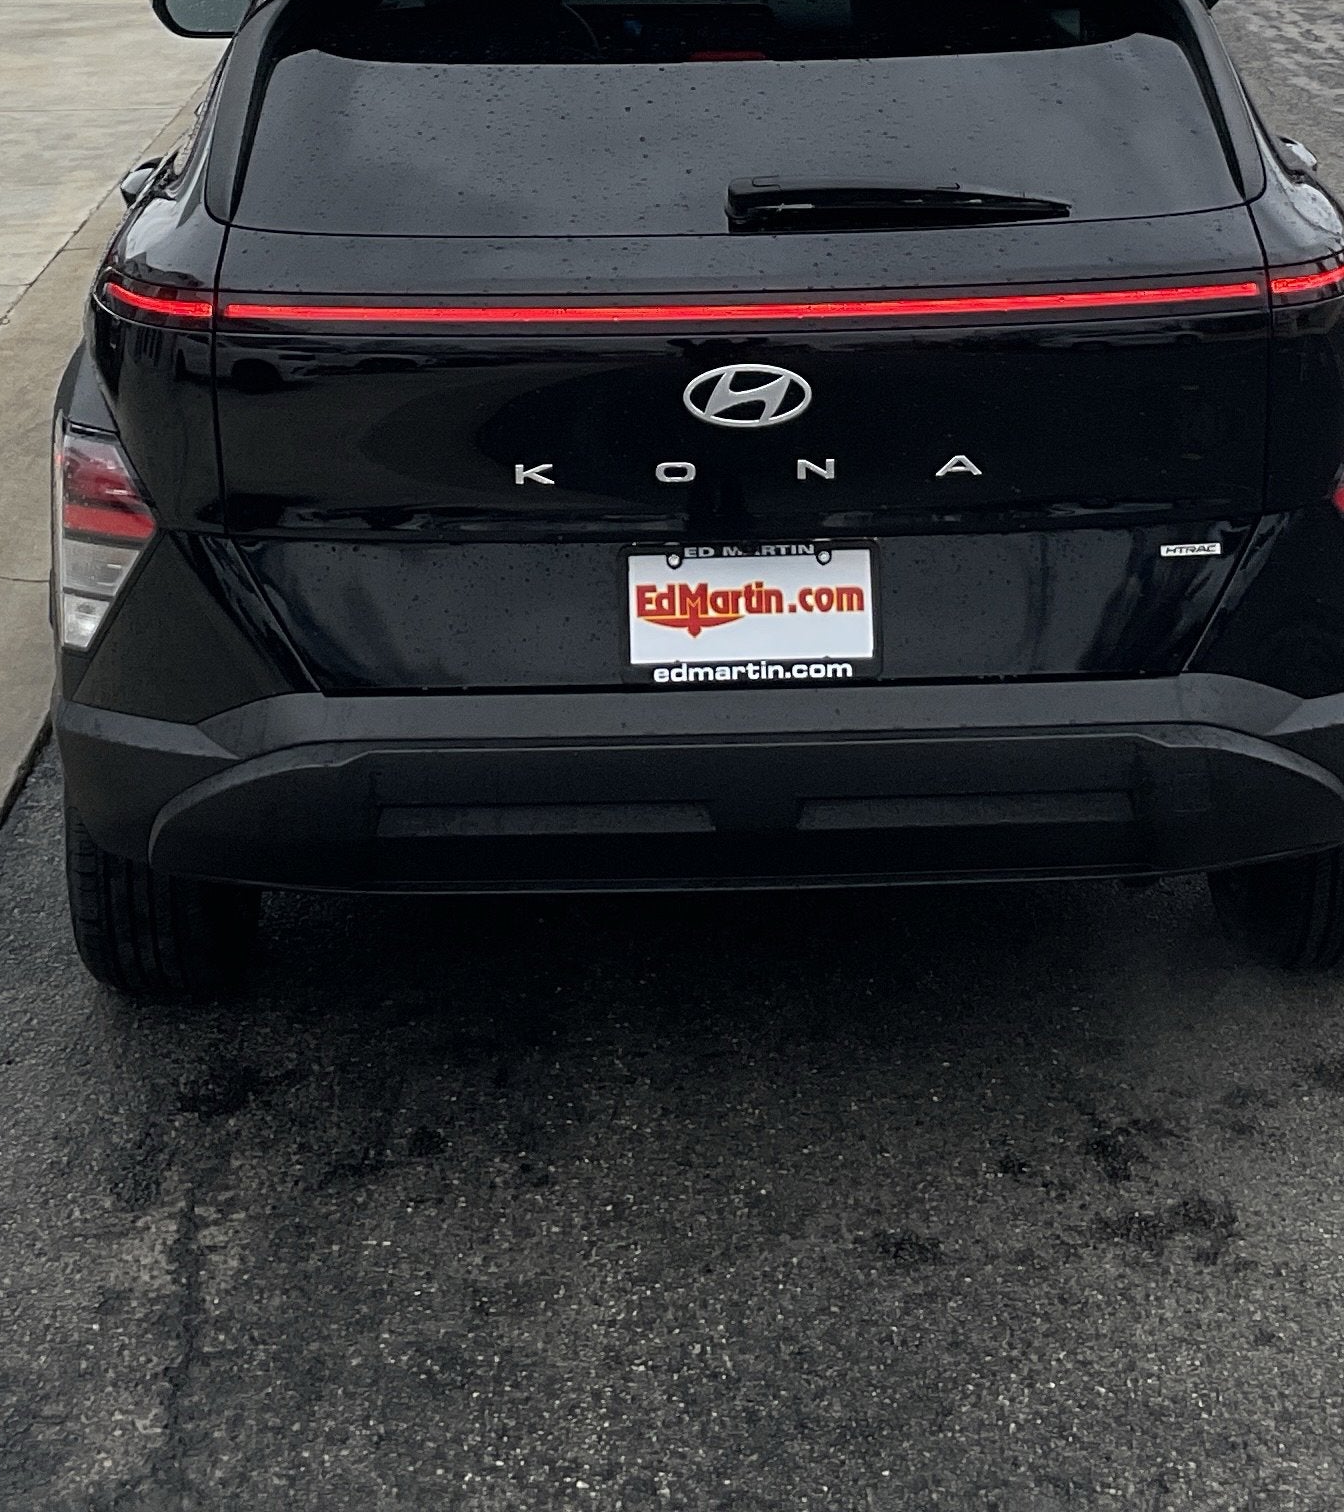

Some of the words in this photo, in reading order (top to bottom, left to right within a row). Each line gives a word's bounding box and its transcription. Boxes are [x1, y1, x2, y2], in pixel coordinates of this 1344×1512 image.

[514, 454, 983, 485] KONA
[684, 546, 715, 559] ED
[1165, 544, 1217, 555] HTRAC
[635, 580, 865, 618] EdMartin.com
[653, 660, 853, 683] edmartin.com
